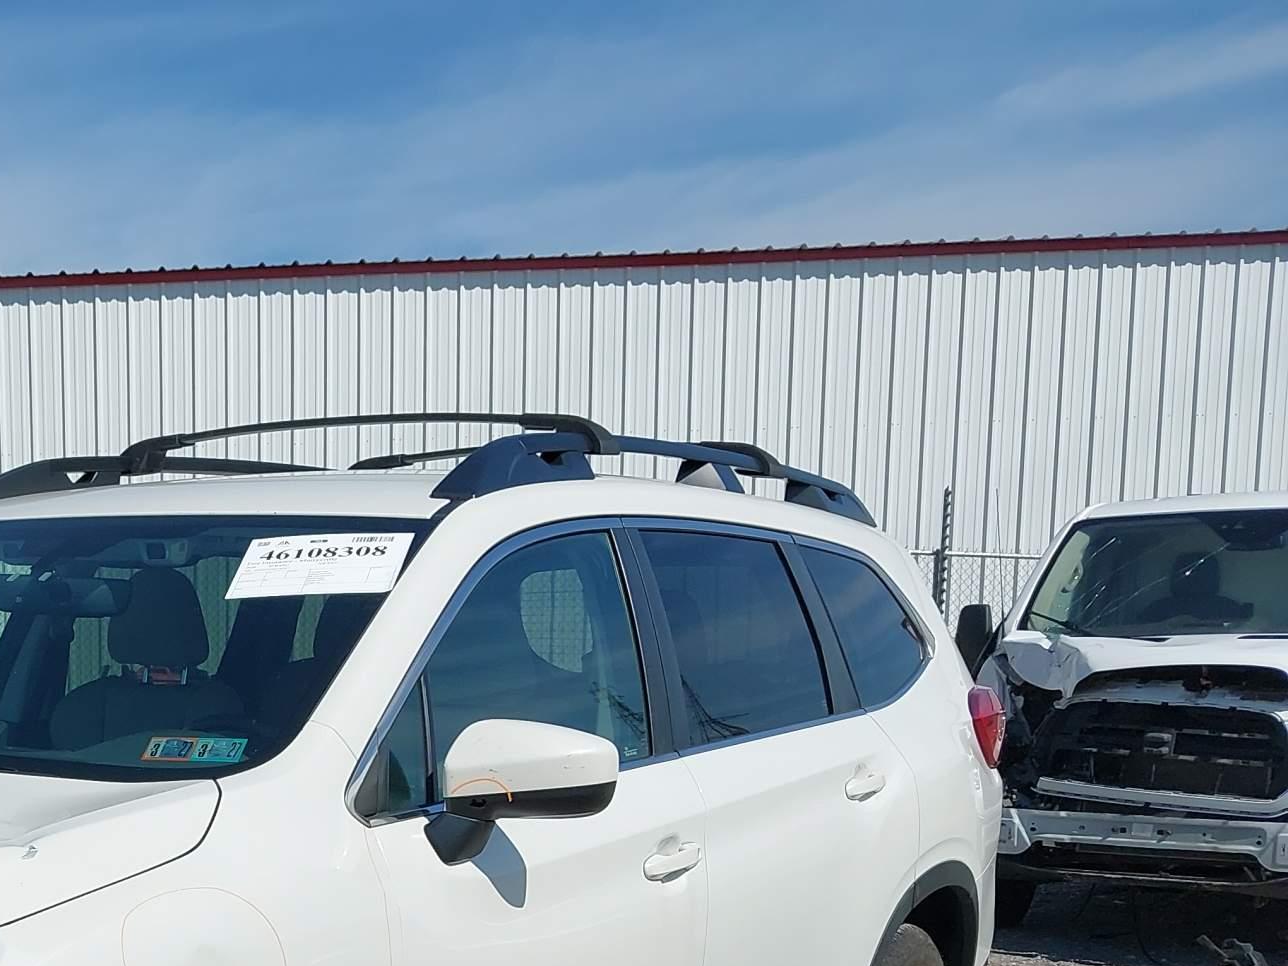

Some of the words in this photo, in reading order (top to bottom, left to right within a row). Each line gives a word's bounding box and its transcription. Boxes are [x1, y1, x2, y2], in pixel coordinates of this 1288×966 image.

[259, 545, 388, 560] 46108308
[150, 743, 161, 757] 3
[198, 743, 210, 758] 3
[227, 741, 243, 758] 27
